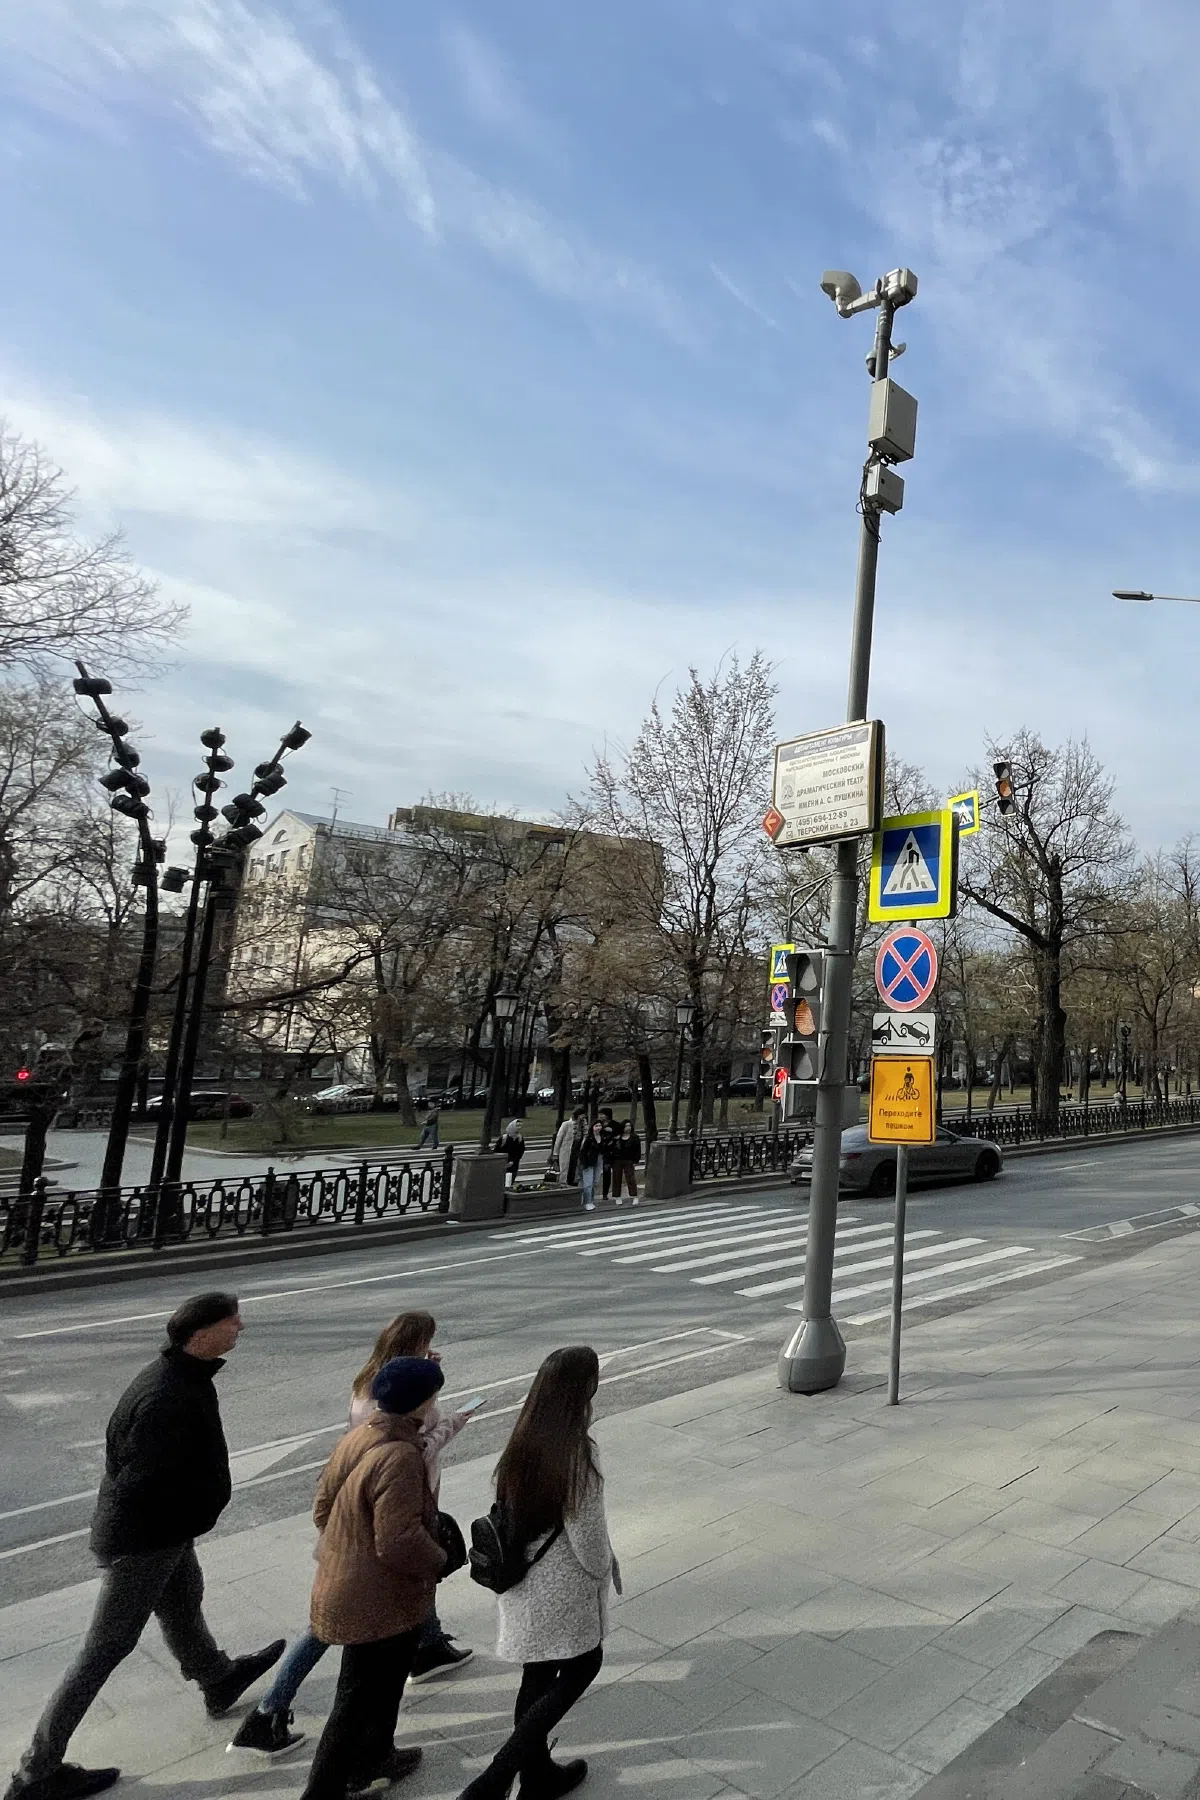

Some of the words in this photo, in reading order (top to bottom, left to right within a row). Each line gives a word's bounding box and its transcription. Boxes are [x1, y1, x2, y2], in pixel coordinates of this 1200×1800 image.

[822, 762, 864, 778] МОСКОВСКИЙ
[796, 779, 846, 798] ДРАМАТИЧЕСКИЙ
[846, 776, 864, 786] ТЕАТР
[798, 798, 818, 810] ИМЕНИ
[834, 790, 864, 802] ПУШКИНА
[796, 816, 812, 828] (495)
[798, 822, 829, 836] ТВЕРСКОЙ
[850, 818, 858, 826] 23
[878, 1108, 922, 1118] Переходите
